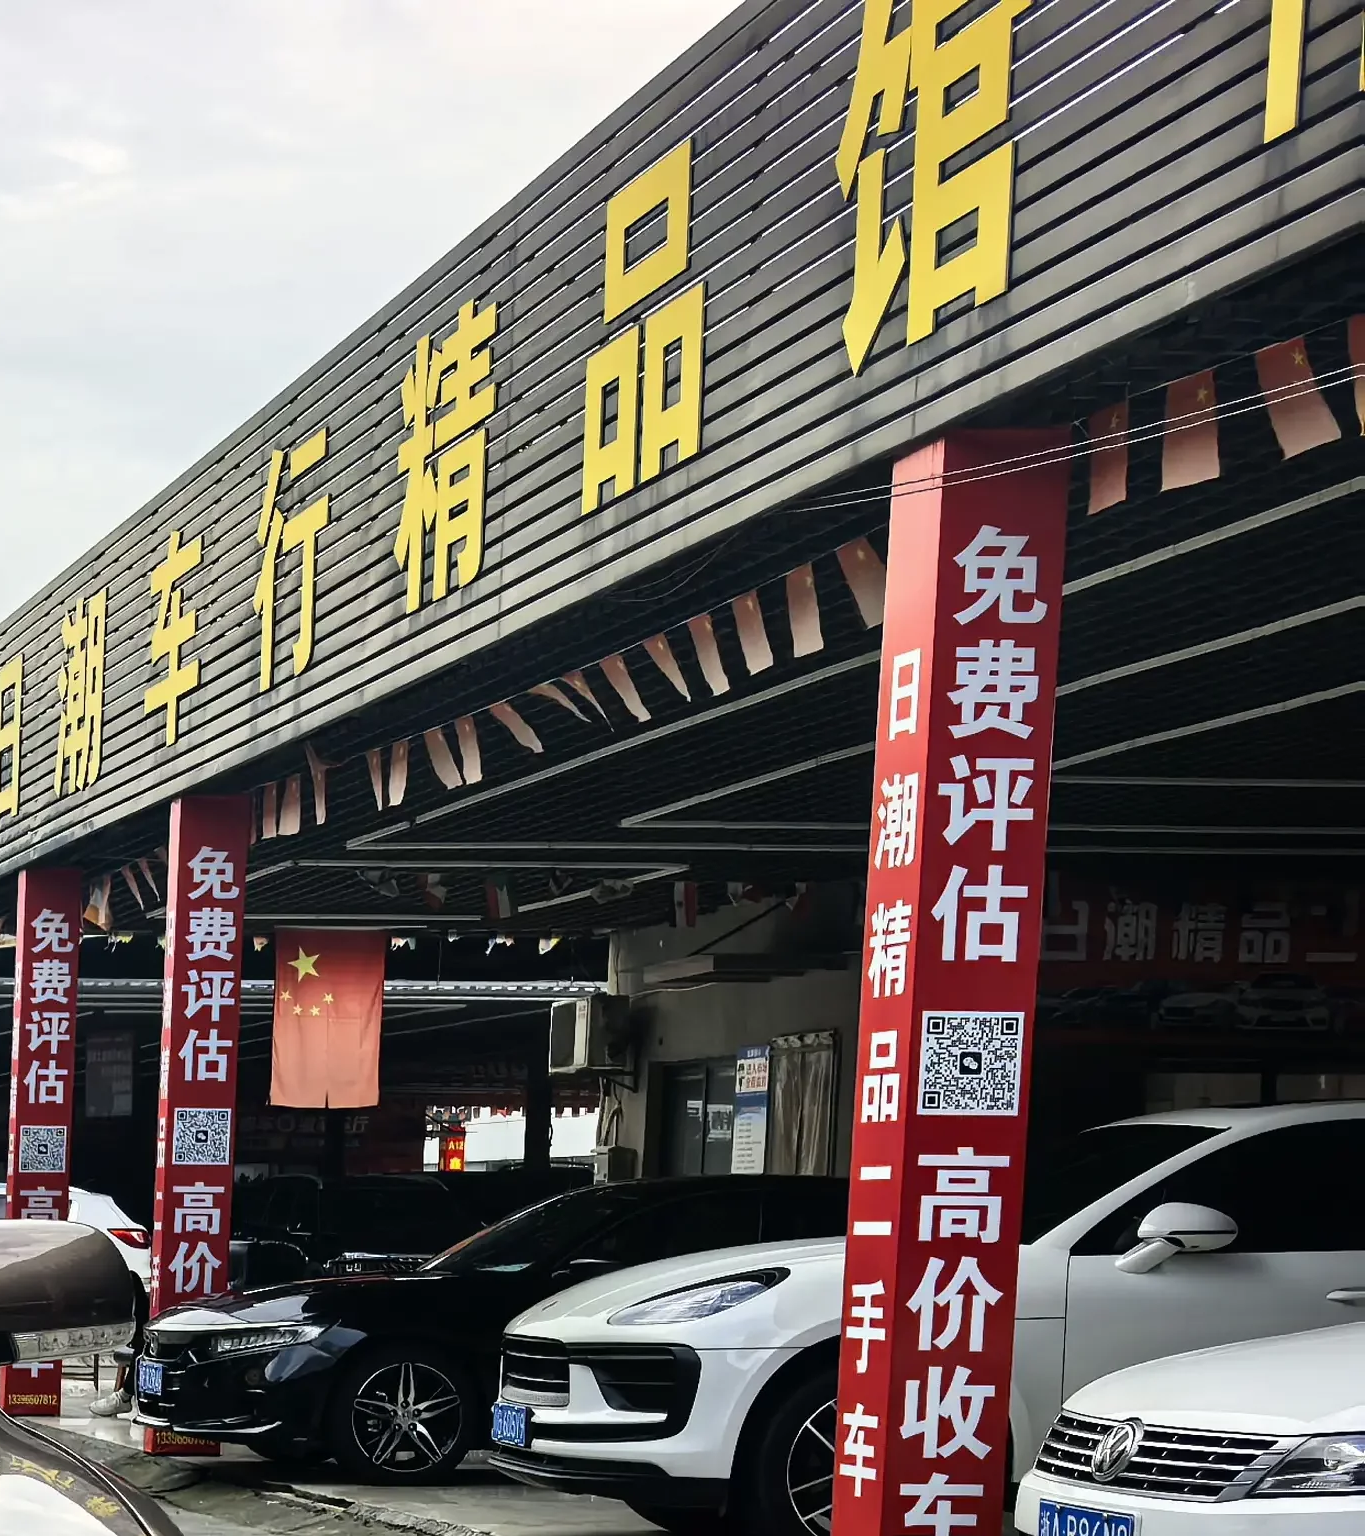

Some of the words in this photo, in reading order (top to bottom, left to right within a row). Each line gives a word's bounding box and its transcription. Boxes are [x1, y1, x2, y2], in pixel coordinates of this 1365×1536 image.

[930, 524, 1048, 964] 免费评估
[23, 908, 75, 1105] 免费评估
[177, 846, 242, 1083] 免费评估
[838, 647, 922, 1498] 日潮精品二手车
[168, 1182, 226, 1295] 高价
